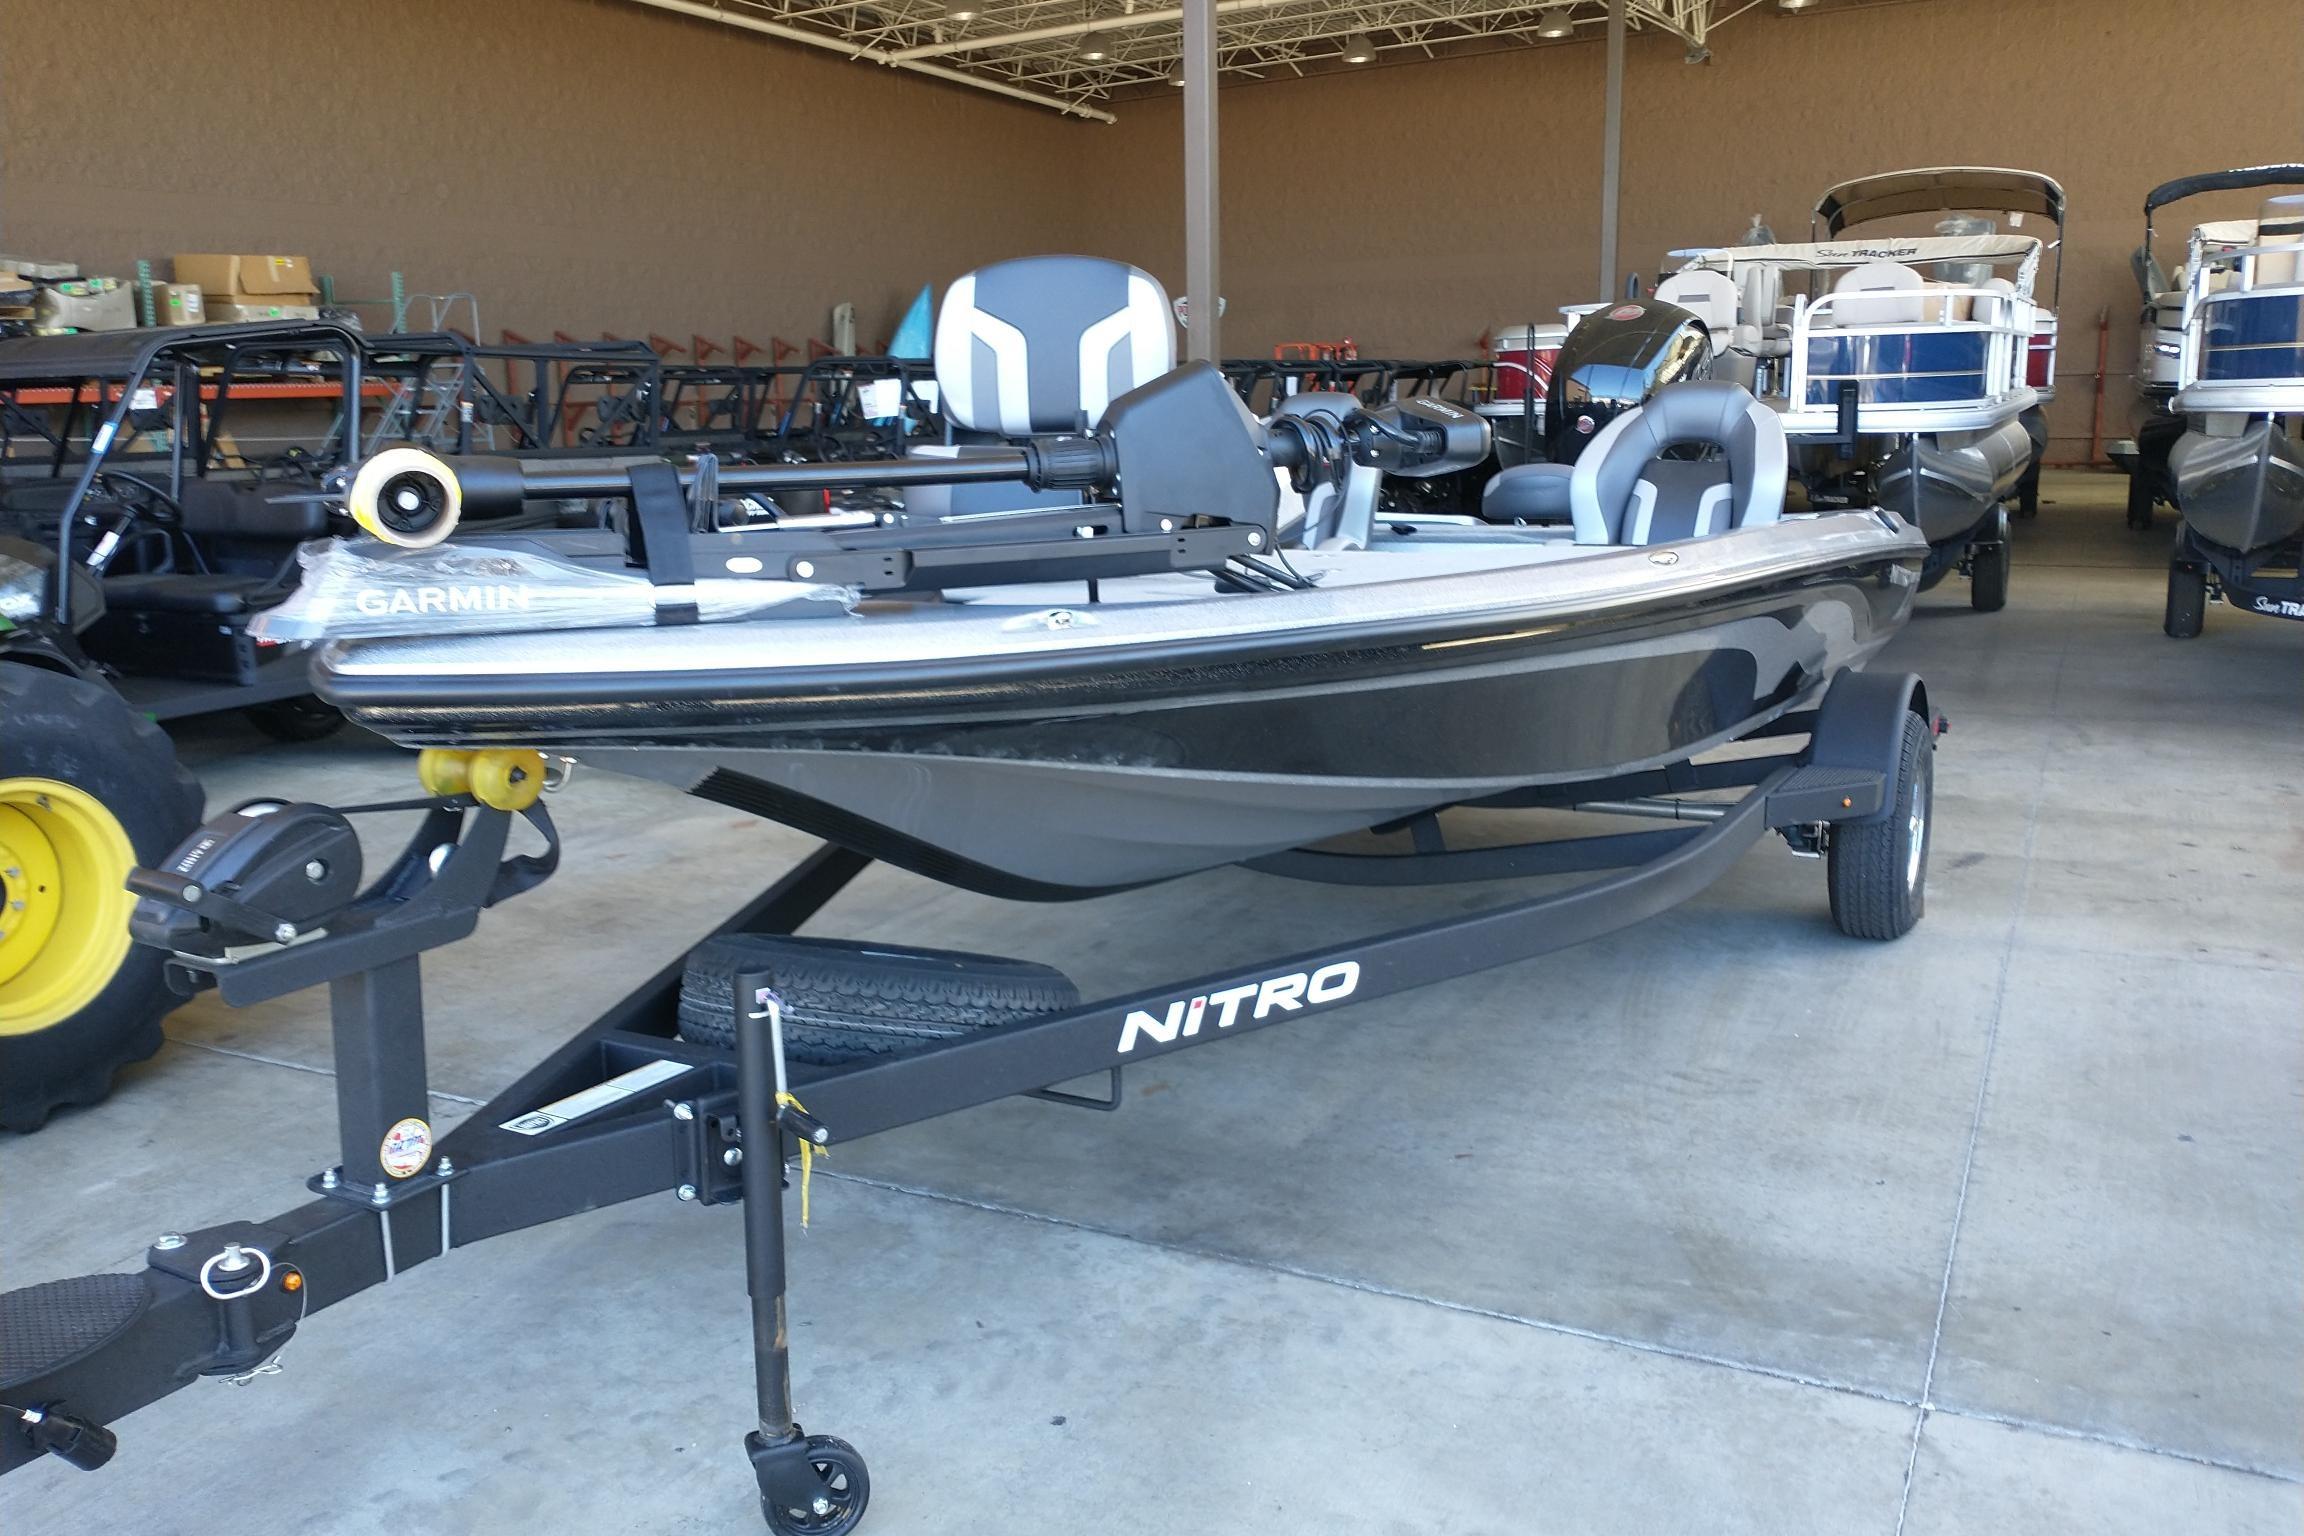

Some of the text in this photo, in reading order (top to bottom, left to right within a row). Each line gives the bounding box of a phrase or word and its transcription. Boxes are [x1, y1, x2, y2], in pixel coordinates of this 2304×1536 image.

[1851, 247, 1918, 259] TRACKER
[355, 584, 531, 617] GARMIN
[1117, 961, 1361, 1053] NITRO
